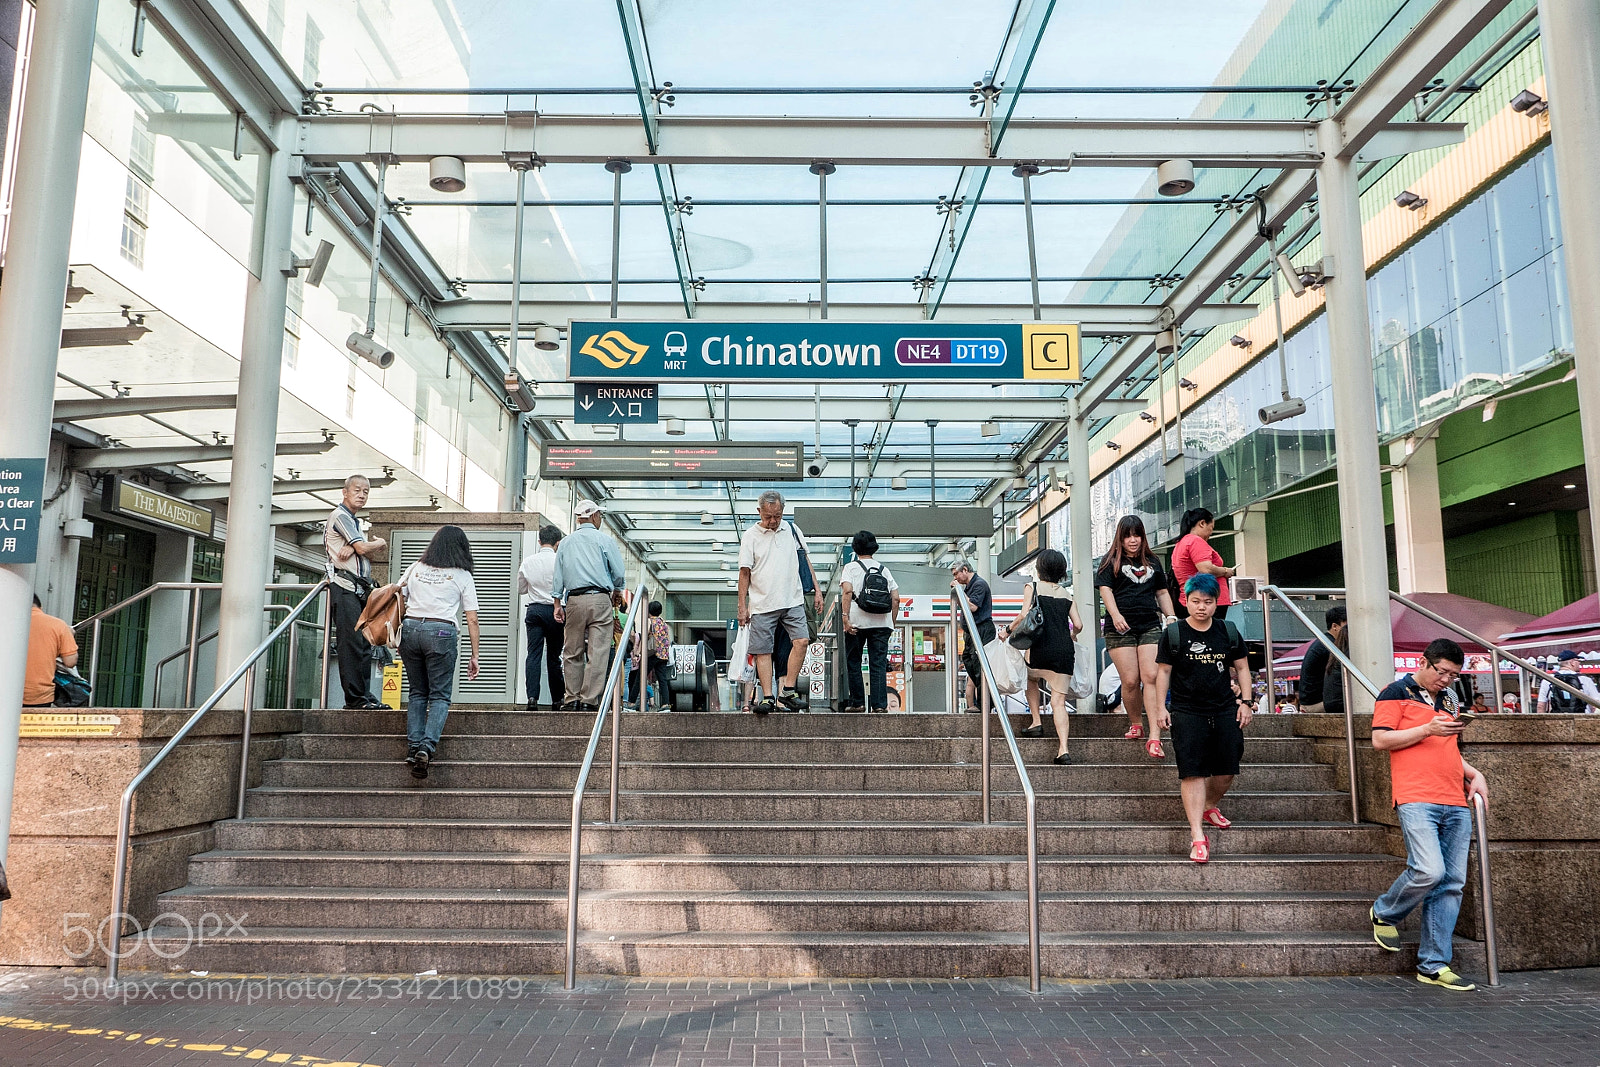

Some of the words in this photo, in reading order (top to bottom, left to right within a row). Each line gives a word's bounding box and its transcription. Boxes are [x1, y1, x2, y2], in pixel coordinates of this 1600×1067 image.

[701, 335, 881, 366] Chinatown
[907, 344, 941, 360] NE4
[956, 344, 1000, 360] DT19
[1042, 341, 1058, 363] C
[664, 360, 687, 370] MRT
[597, 388, 654, 399] ENTRANCE
[608, 401, 642, 418] 入口
[0, 469, 22, 480] tion
[7, 498, 35, 508] Clear
[133, 490, 155, 512] THE
[156, 498, 202, 526] MAJESTIC
[1, 537, 17, 552] 用
